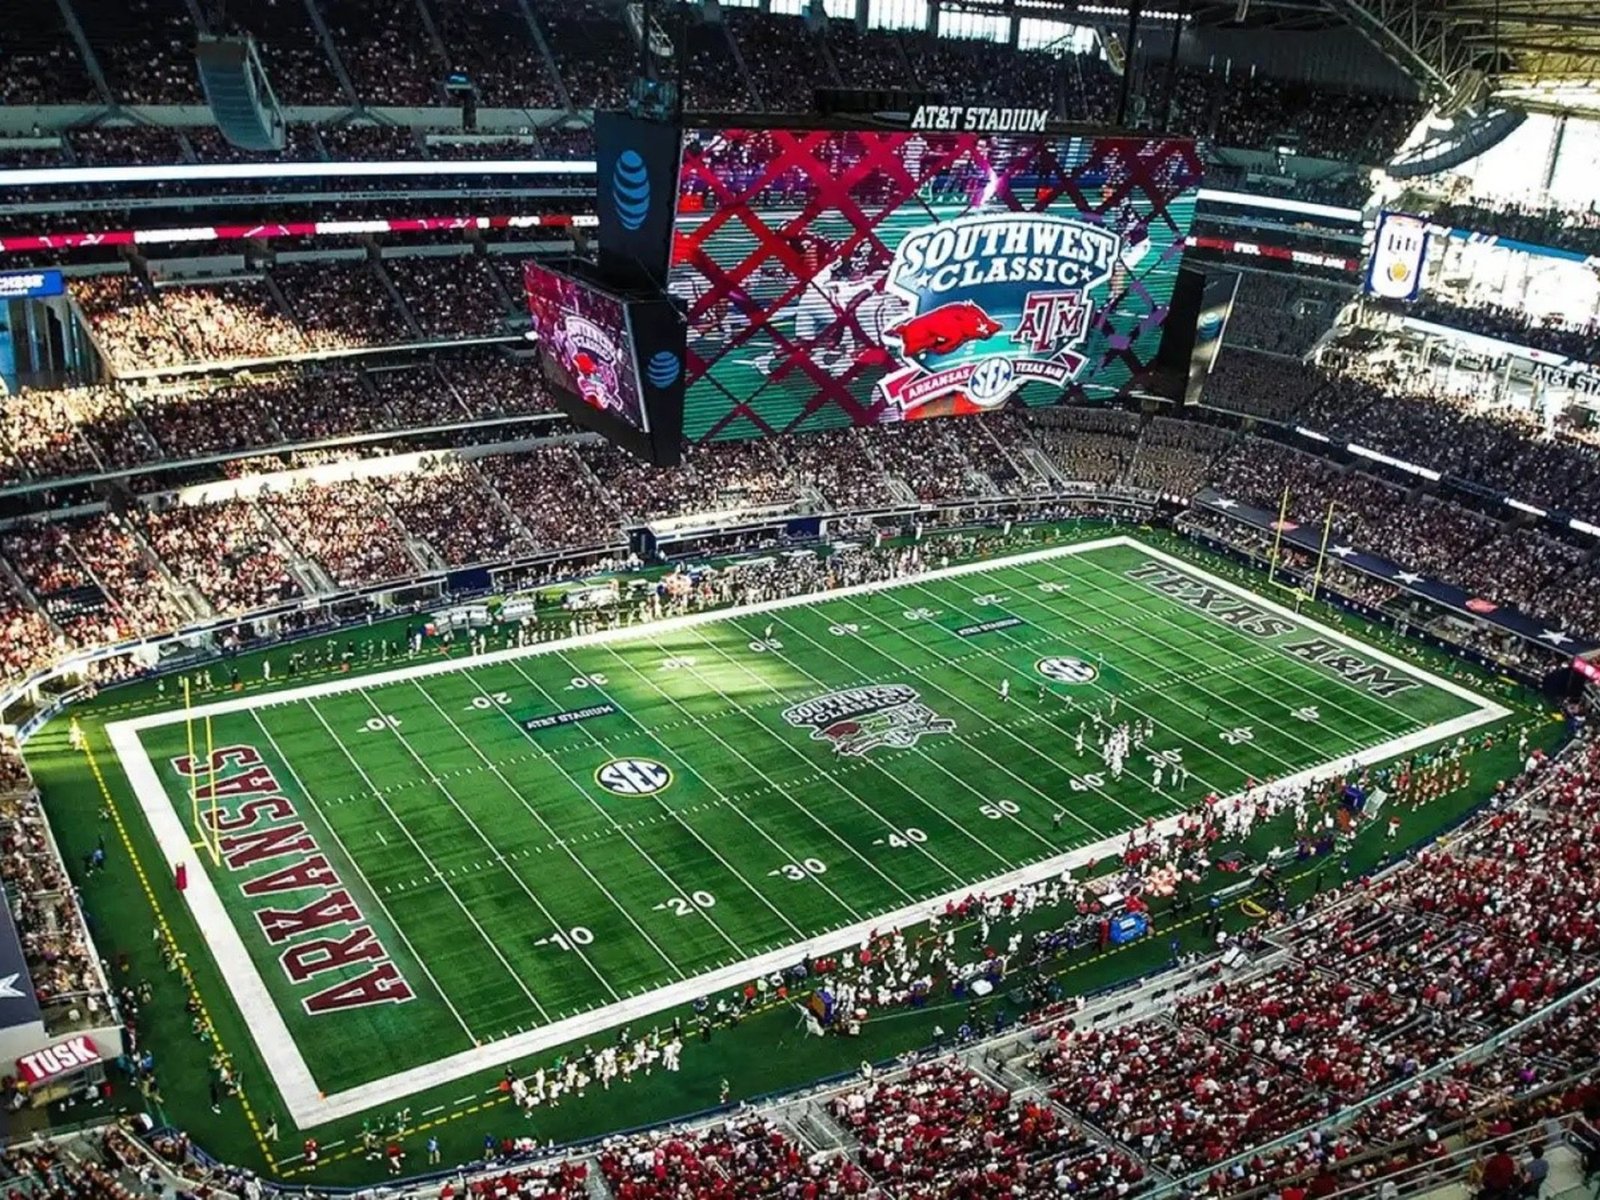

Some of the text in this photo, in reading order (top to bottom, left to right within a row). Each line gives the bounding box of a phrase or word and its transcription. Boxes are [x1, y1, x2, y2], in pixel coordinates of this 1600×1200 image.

[911, 105, 1049, 132] AT&T STADIUM
[899, 222, 1113, 277] SOUTHWEST
[932, 257, 1079, 292] CLASSIC
[907, 369, 971, 400] ARKANSAS
[971, 358, 1011, 398] SEC
[1016, 361, 1045, 374] TEXAS
[1532, 364, 1574, 389] AT&T
[1124, 560, 1423, 699] TEXAS A&M
[787, 686, 913, 723] SOUTHWEST
[599, 758, 669, 794] SEC
[978, 799, 1021, 820] 50
[170, 743, 417, 1016] ARKANSAS
[21, 1036, 98, 1079] TUSK
